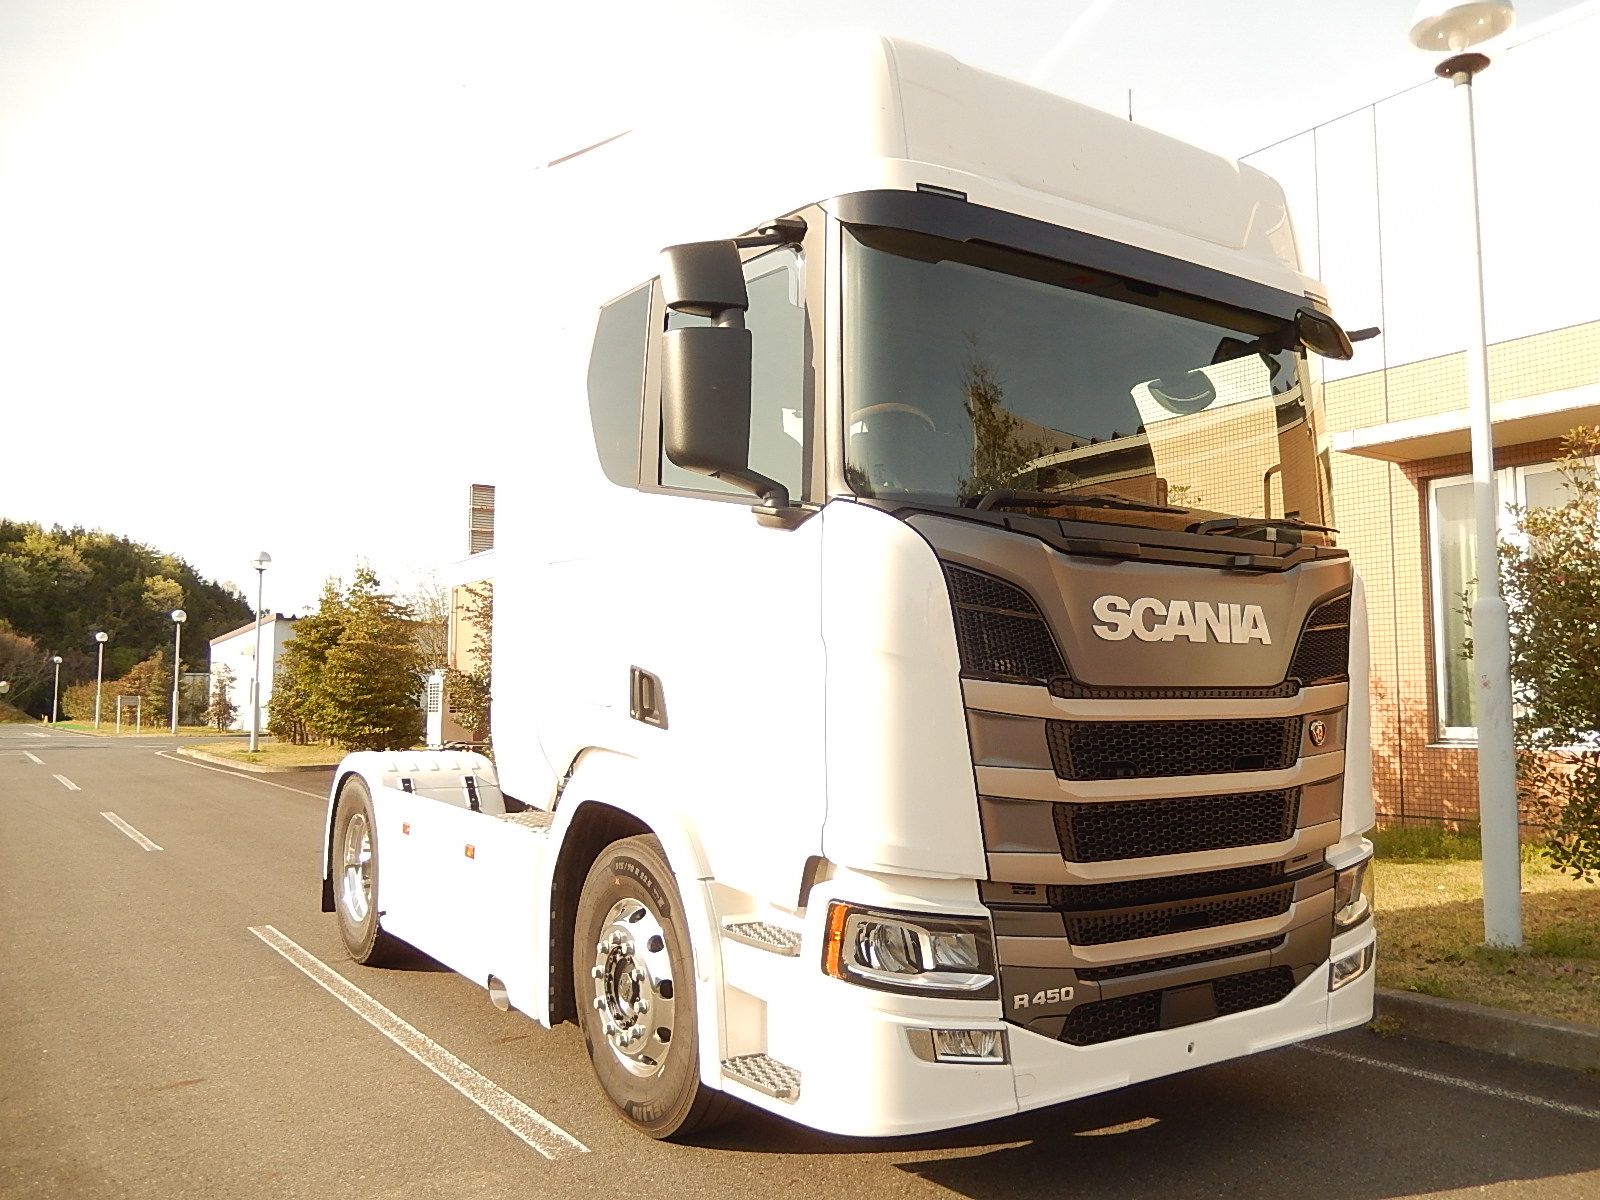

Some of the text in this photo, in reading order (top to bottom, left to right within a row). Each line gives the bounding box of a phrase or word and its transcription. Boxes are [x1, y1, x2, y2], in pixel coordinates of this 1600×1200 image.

[1092, 595, 1272, 645] SCANIA
[1013, 986, 1074, 1010] R 450
